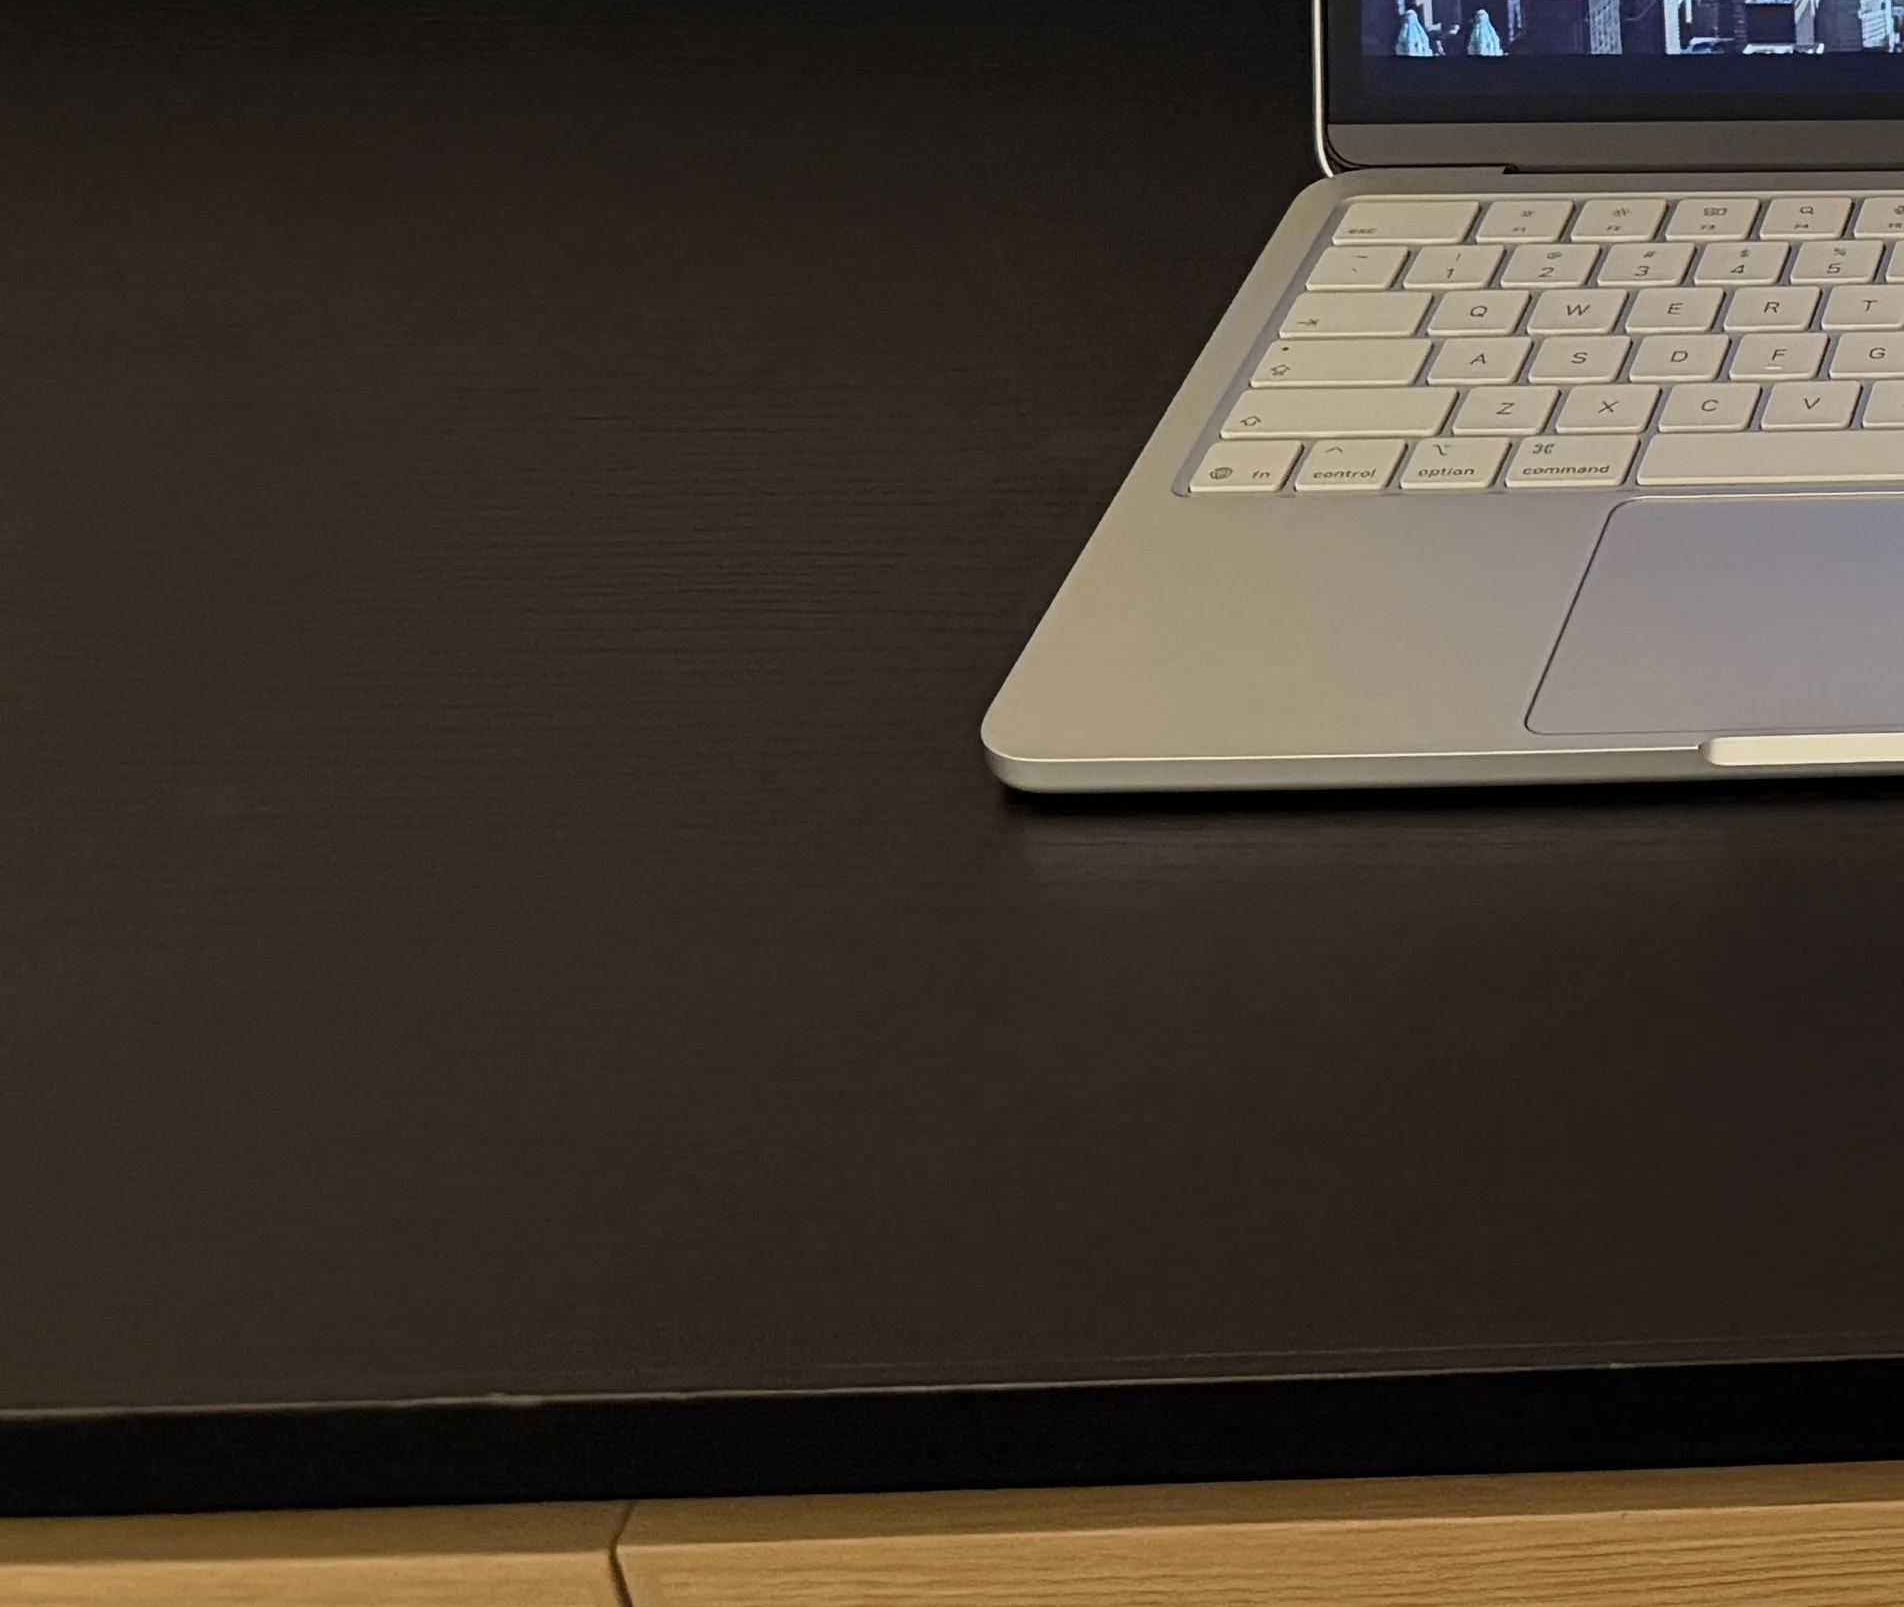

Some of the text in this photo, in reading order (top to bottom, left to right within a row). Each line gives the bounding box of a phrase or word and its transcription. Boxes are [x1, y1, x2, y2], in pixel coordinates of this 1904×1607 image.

[1447, 268, 1455, 279] 1
[1537, 266, 1555, 279] 2
[1634, 265, 1650, 277] 3
[1730, 264, 1745, 275] 4
[1826, 262, 1841, 274] 5
[1469, 305, 1488, 318] Q
[1566, 304, 1591, 316] W
[1667, 302, 1683, 315] E
[1763, 301, 1780, 313] R
[1864, 299, 1877, 312] T
[1469, 353, 1487, 365] A
[1571, 352, 1589, 365] S
[1670, 350, 1689, 363] D
[1771, 348, 1787, 361] F
[1868, 347, 1886, 360] G
[1495, 402, 1515, 415] Z
[1598, 400, 1619, 414] X
[1700, 399, 1719, 412] C
[1804, 397, 1821, 410] V
[1312, 468, 1377, 479] control
[1418, 467, 1475, 478] option
[1522, 464, 1610, 475] command
